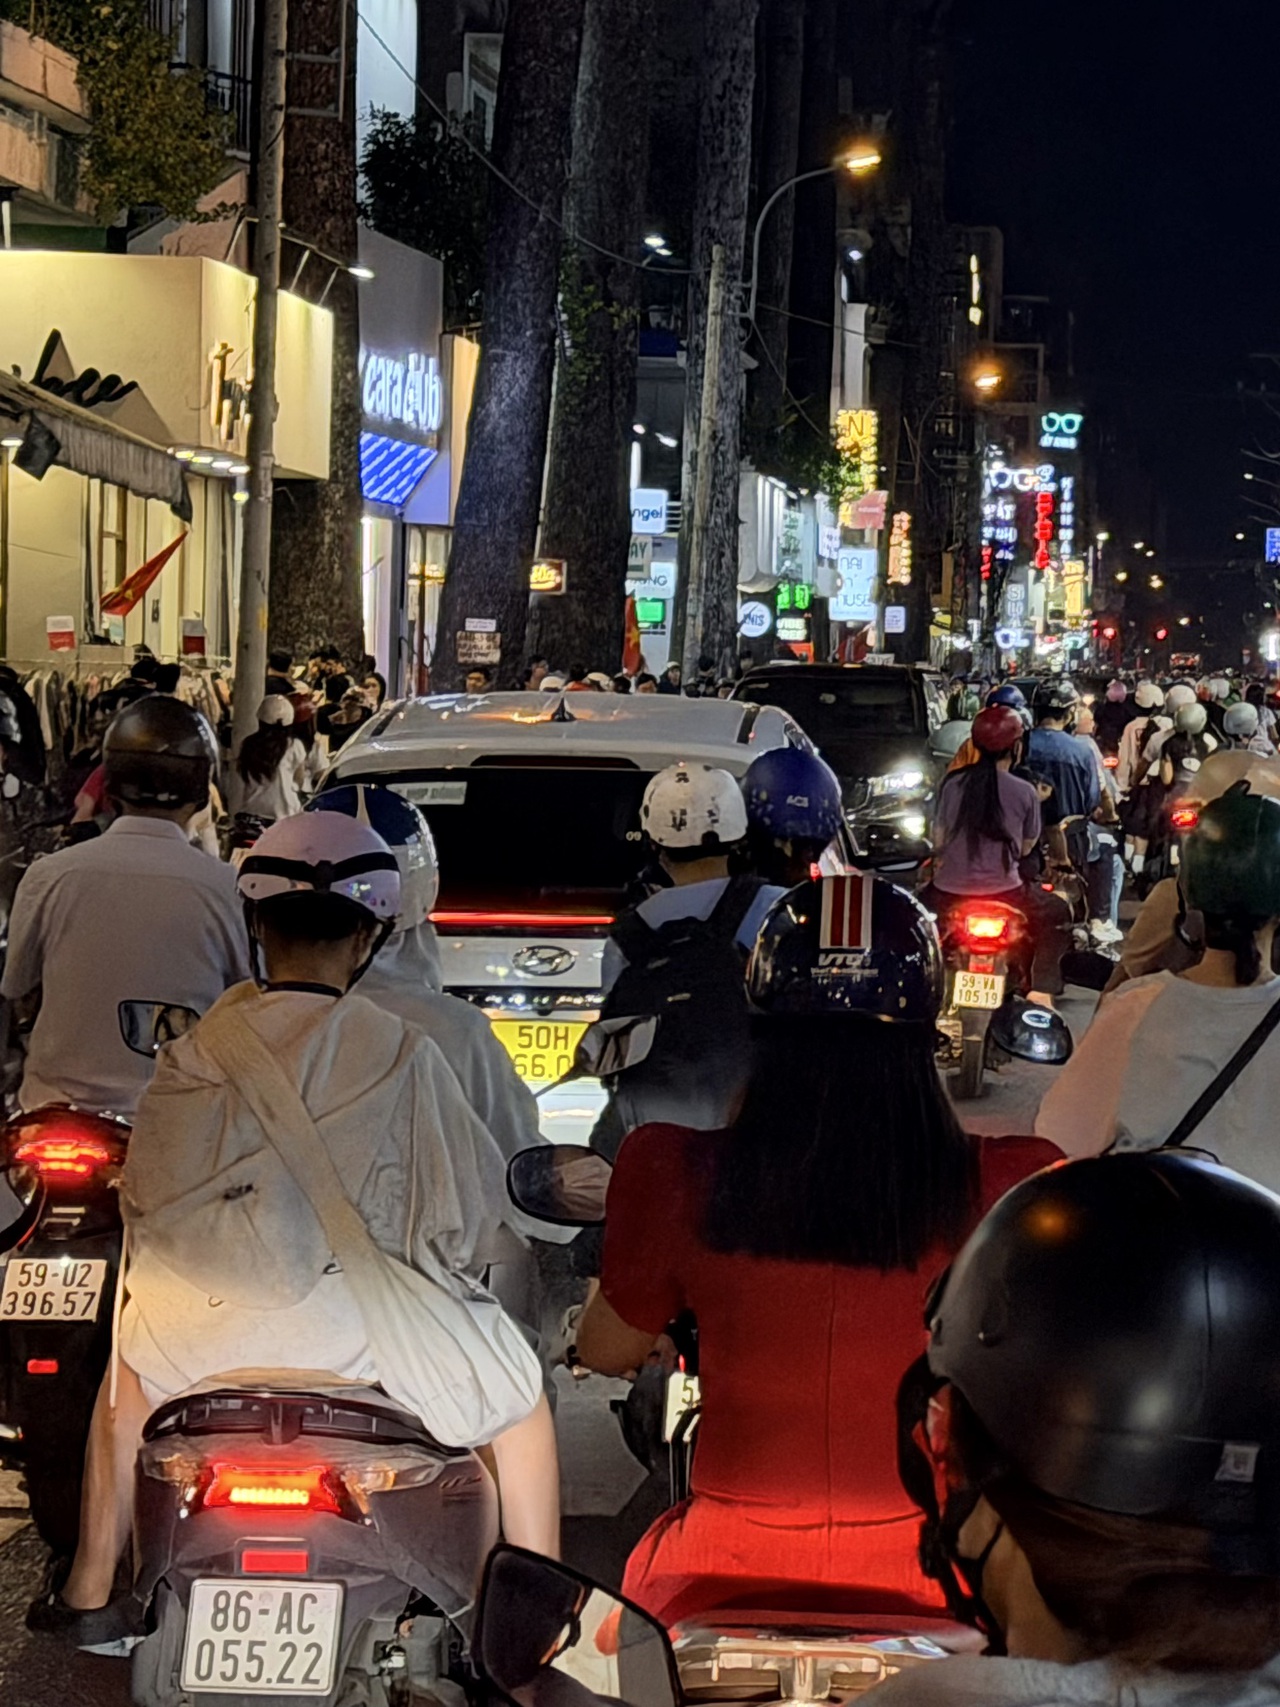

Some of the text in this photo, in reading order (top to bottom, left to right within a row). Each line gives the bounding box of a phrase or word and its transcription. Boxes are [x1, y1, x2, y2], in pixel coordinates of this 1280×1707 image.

[631, 505, 664, 521] ngel
[517, 1025, 569, 1050] 50H
[514, 1053, 572, 1078] 66.0
[18, 1262, 92, 1288] 59-U2
[3, 1290, 97, 1317] 396.57
[211, 1589, 319, 1635] 86-AC
[194, 1638, 324, 1686] 055.22
